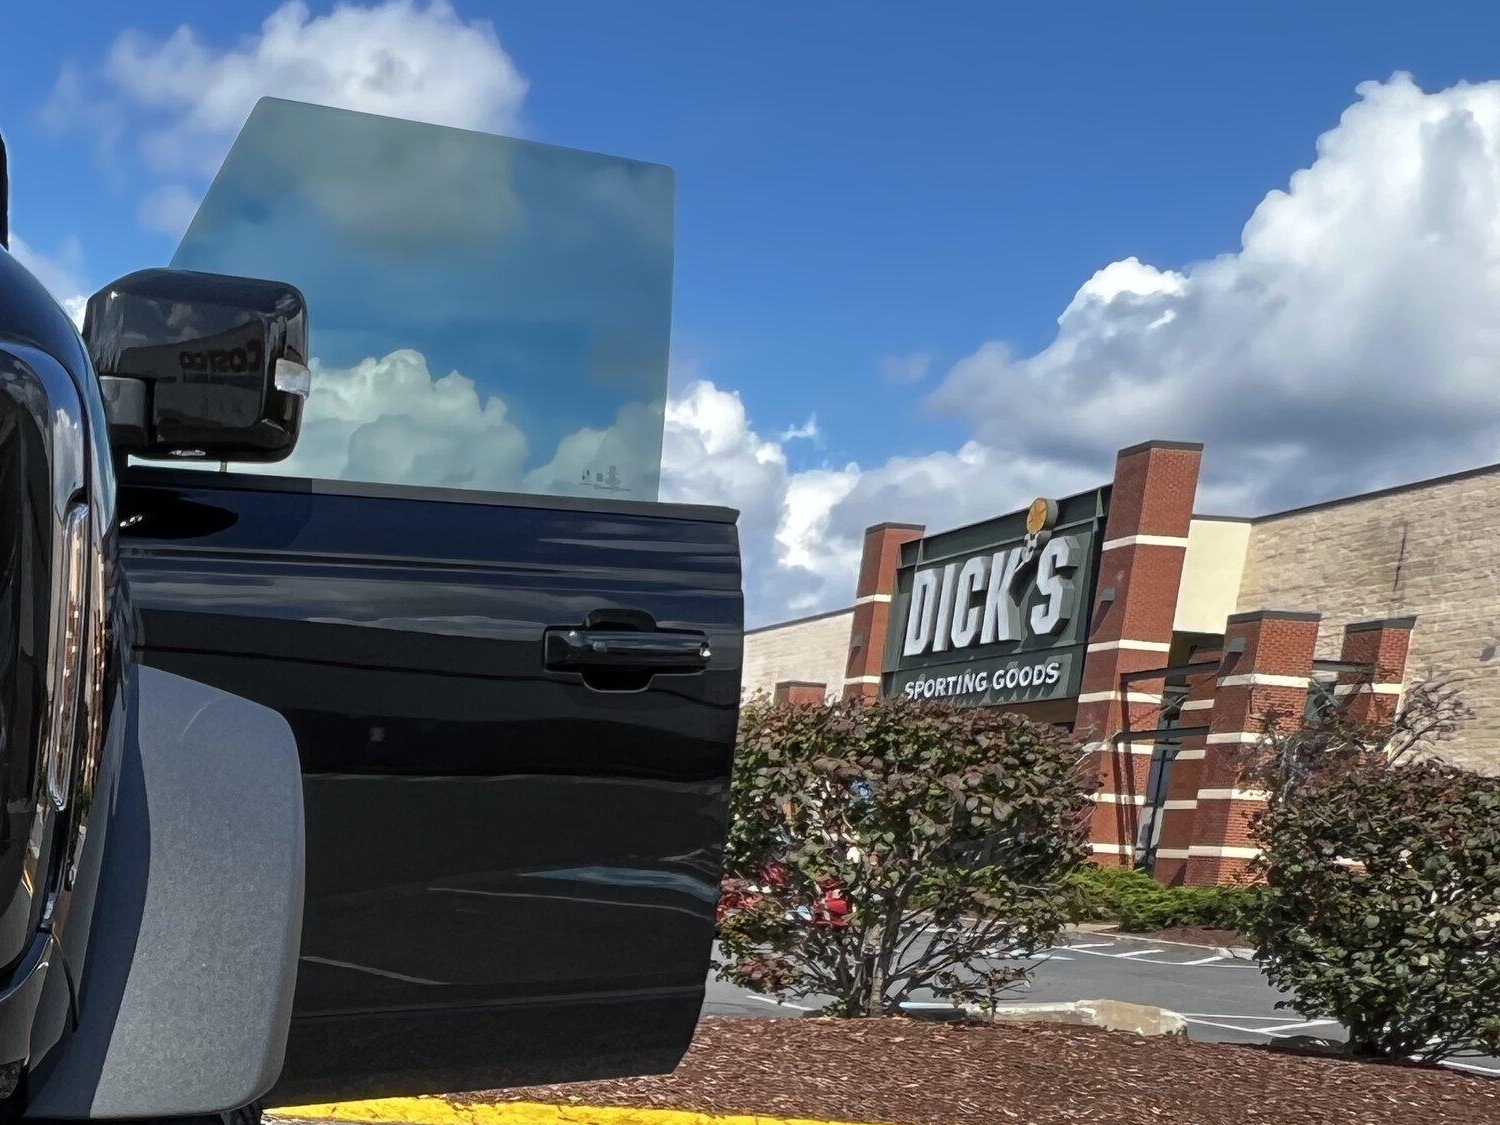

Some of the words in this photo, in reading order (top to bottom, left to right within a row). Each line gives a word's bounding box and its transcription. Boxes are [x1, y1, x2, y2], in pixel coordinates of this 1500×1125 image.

[903, 534, 1076, 657] DICK'S
[905, 671, 988, 700] SPORTING
[992, 661, 1061, 691] GOODS
